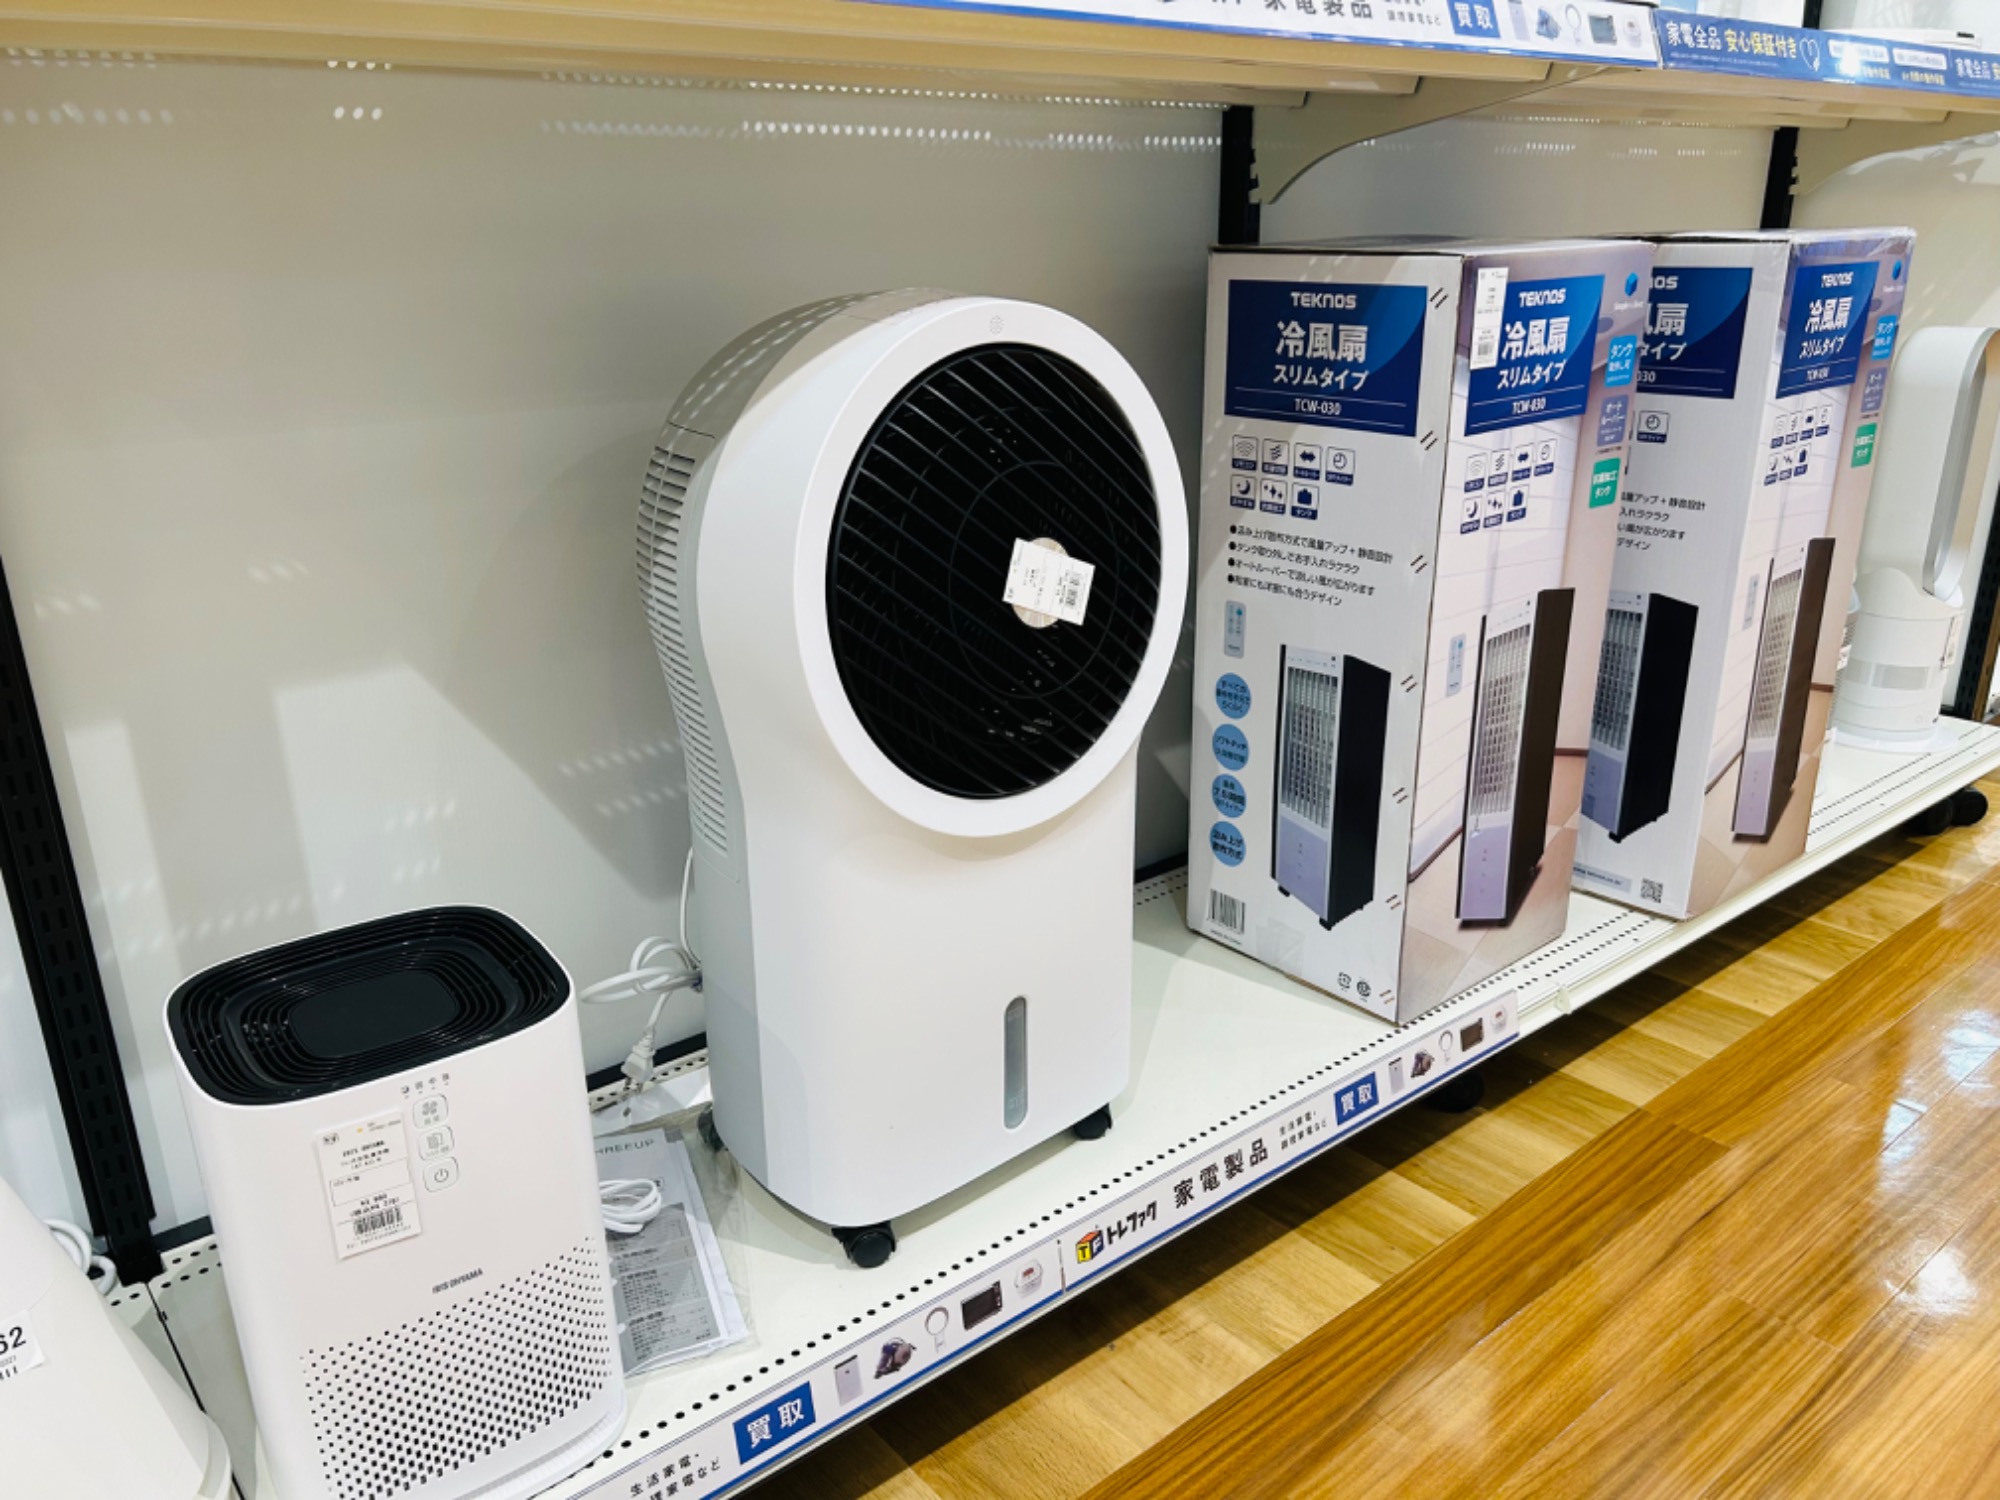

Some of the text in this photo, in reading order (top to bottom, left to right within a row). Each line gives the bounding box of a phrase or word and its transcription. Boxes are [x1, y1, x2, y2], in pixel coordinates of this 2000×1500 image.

[1453, 5, 1494, 30] 買取
[1665, 20, 1722, 51] 家電全品
[1723, 28, 1798, 60] 安心保証付き
[1804, 295, 1854, 334] 冷風扇
[1275, 320, 1369, 364] 冷風扇
[1501, 315, 1571, 361] 冷風扇
[1799, 334, 1846, 360] スリムタイプ
[1272, 363, 1371, 391] スリムタイプ
[1496, 358, 1568, 390] スリムタイプ
[1294, 398, 1342, 416] TCW-030
[1341, 1081, 1374, 1116] 買取
[1173, 1137, 1269, 1210] 家電製品
[1106, 1201, 1158, 1246] トレファク
[746, 1398, 804, 1449] 買取
